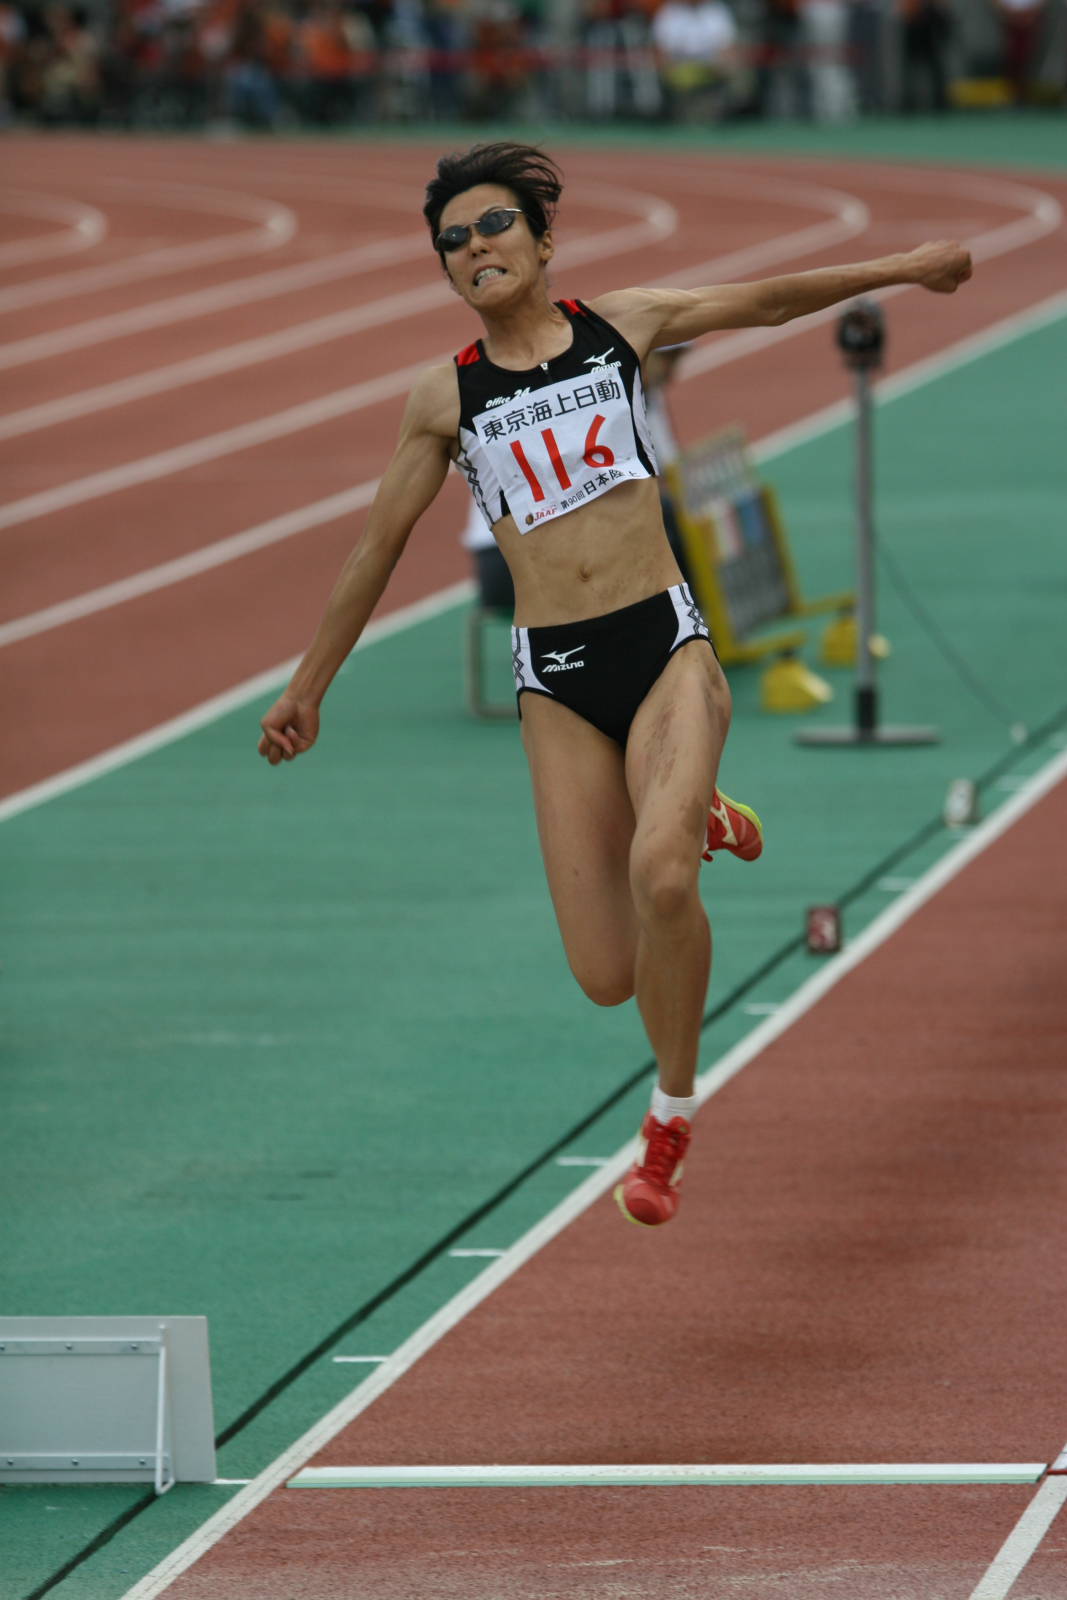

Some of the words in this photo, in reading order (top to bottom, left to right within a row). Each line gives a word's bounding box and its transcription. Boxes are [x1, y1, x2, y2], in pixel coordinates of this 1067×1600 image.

[482, 379, 621, 444] 東京海上日動
[510, 414, 615, 503] 116
